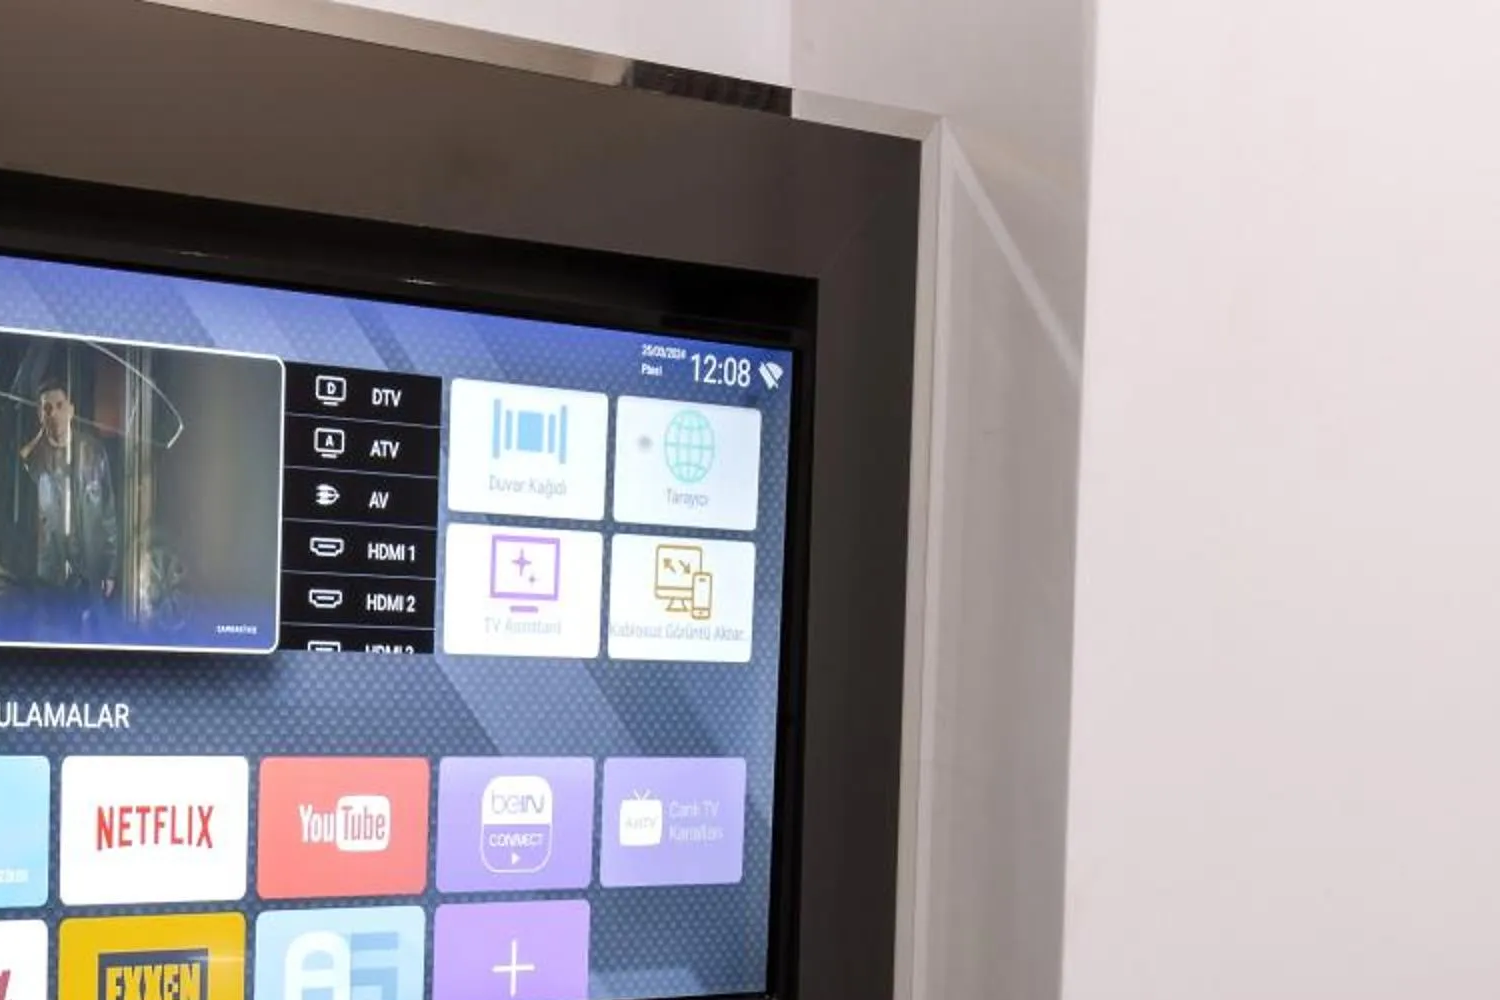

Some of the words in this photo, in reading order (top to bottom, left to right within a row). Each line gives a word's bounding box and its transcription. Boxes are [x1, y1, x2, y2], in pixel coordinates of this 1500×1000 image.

[691, 352, 751, 388] 12:08
[371, 387, 403, 408] DTV
[369, 439, 400, 459] ATV
[368, 490, 389, 509] AV
[367, 542, 405, 561] HDMI
[408, 544, 416, 562] 1
[366, 593, 404, 612] HDMI
[406, 595, 416, 613] 2
[97, 804, 215, 851] NETFLIX
[298, 804, 386, 844] YouTube
